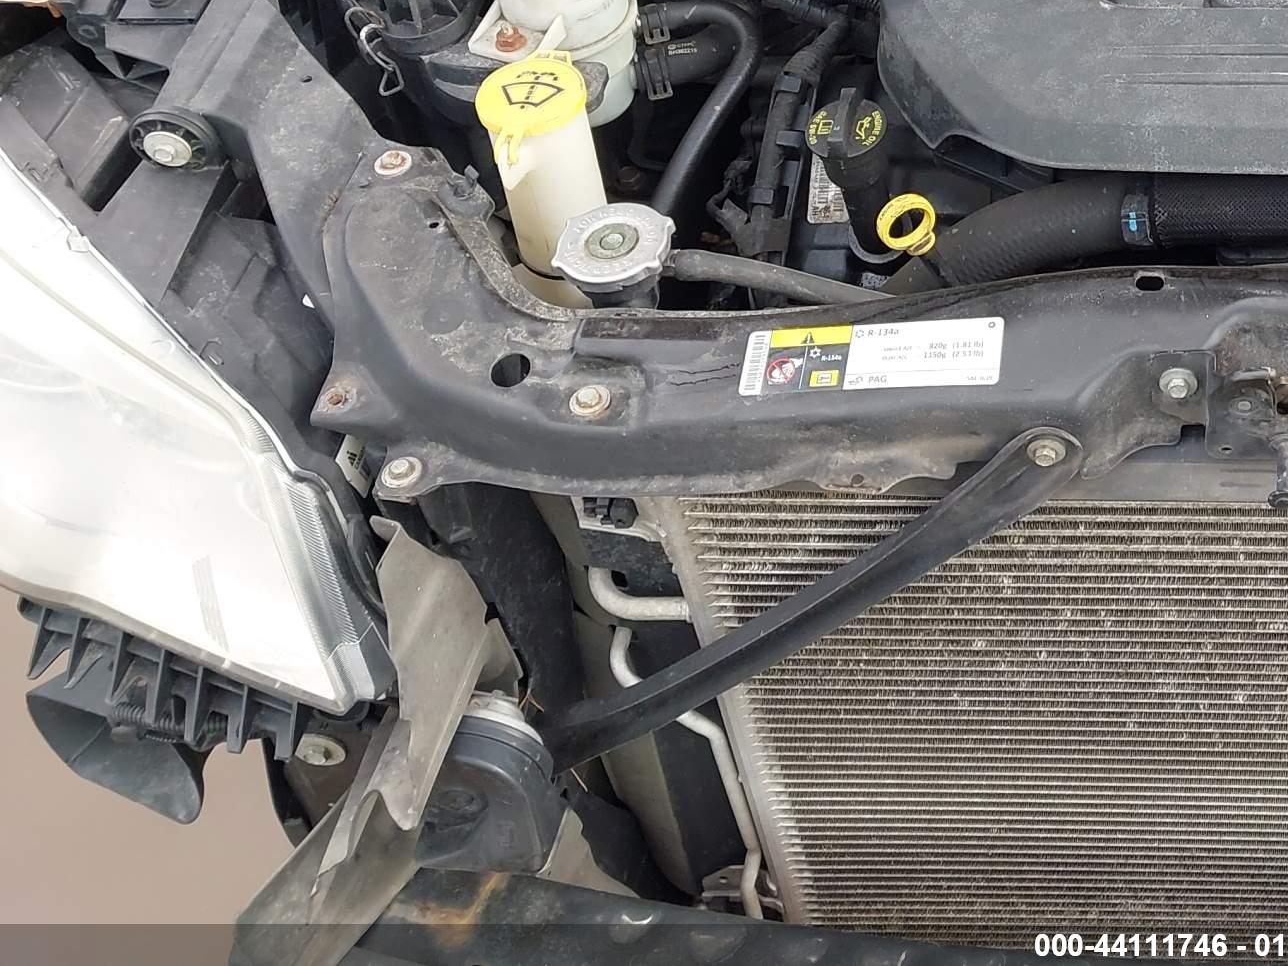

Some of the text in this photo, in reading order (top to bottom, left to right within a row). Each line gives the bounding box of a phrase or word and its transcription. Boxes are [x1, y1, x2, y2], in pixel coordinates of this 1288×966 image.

[862, 110, 882, 146] ENGINE OIL
[868, 328, 899, 336] R-134a
[820, 354, 842, 362] R-134a
[868, 375, 887, 384] PAG
